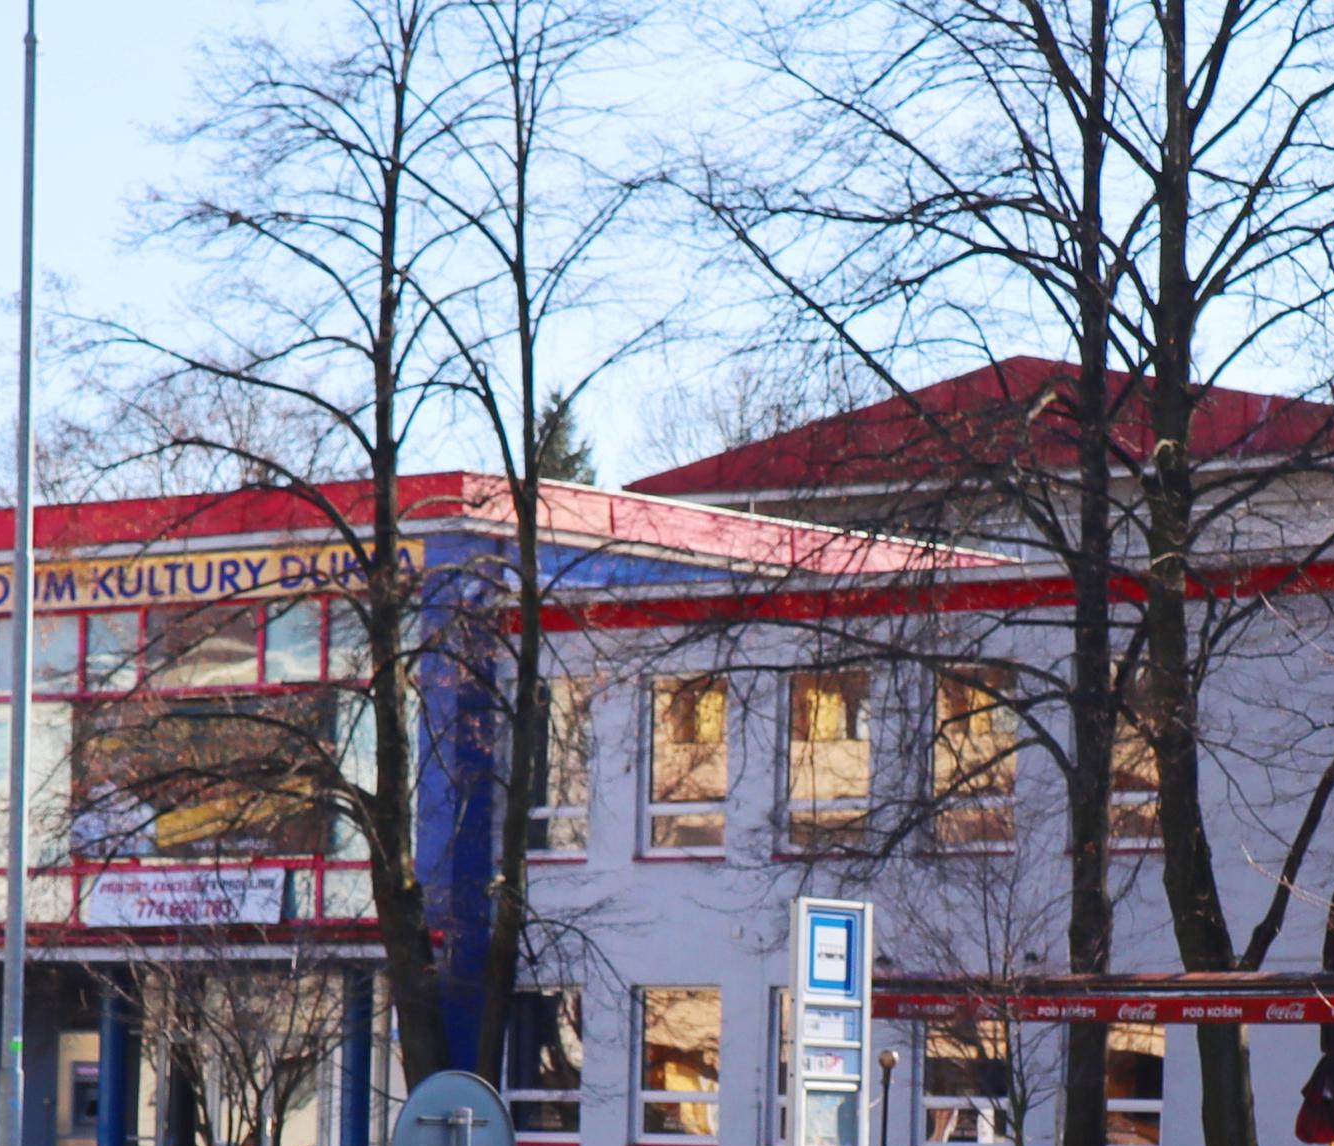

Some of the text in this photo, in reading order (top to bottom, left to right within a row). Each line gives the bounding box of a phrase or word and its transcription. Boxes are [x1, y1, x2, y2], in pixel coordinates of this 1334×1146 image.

[91, 557, 268, 600] KULTURY
[280, 547, 419, 589] DUKA
[1038, 1006, 1060, 1017] POD
[1182, 1004, 1244, 1018] POD KOŠEM
[1265, 1002, 1307, 1021] Coca-Cola
